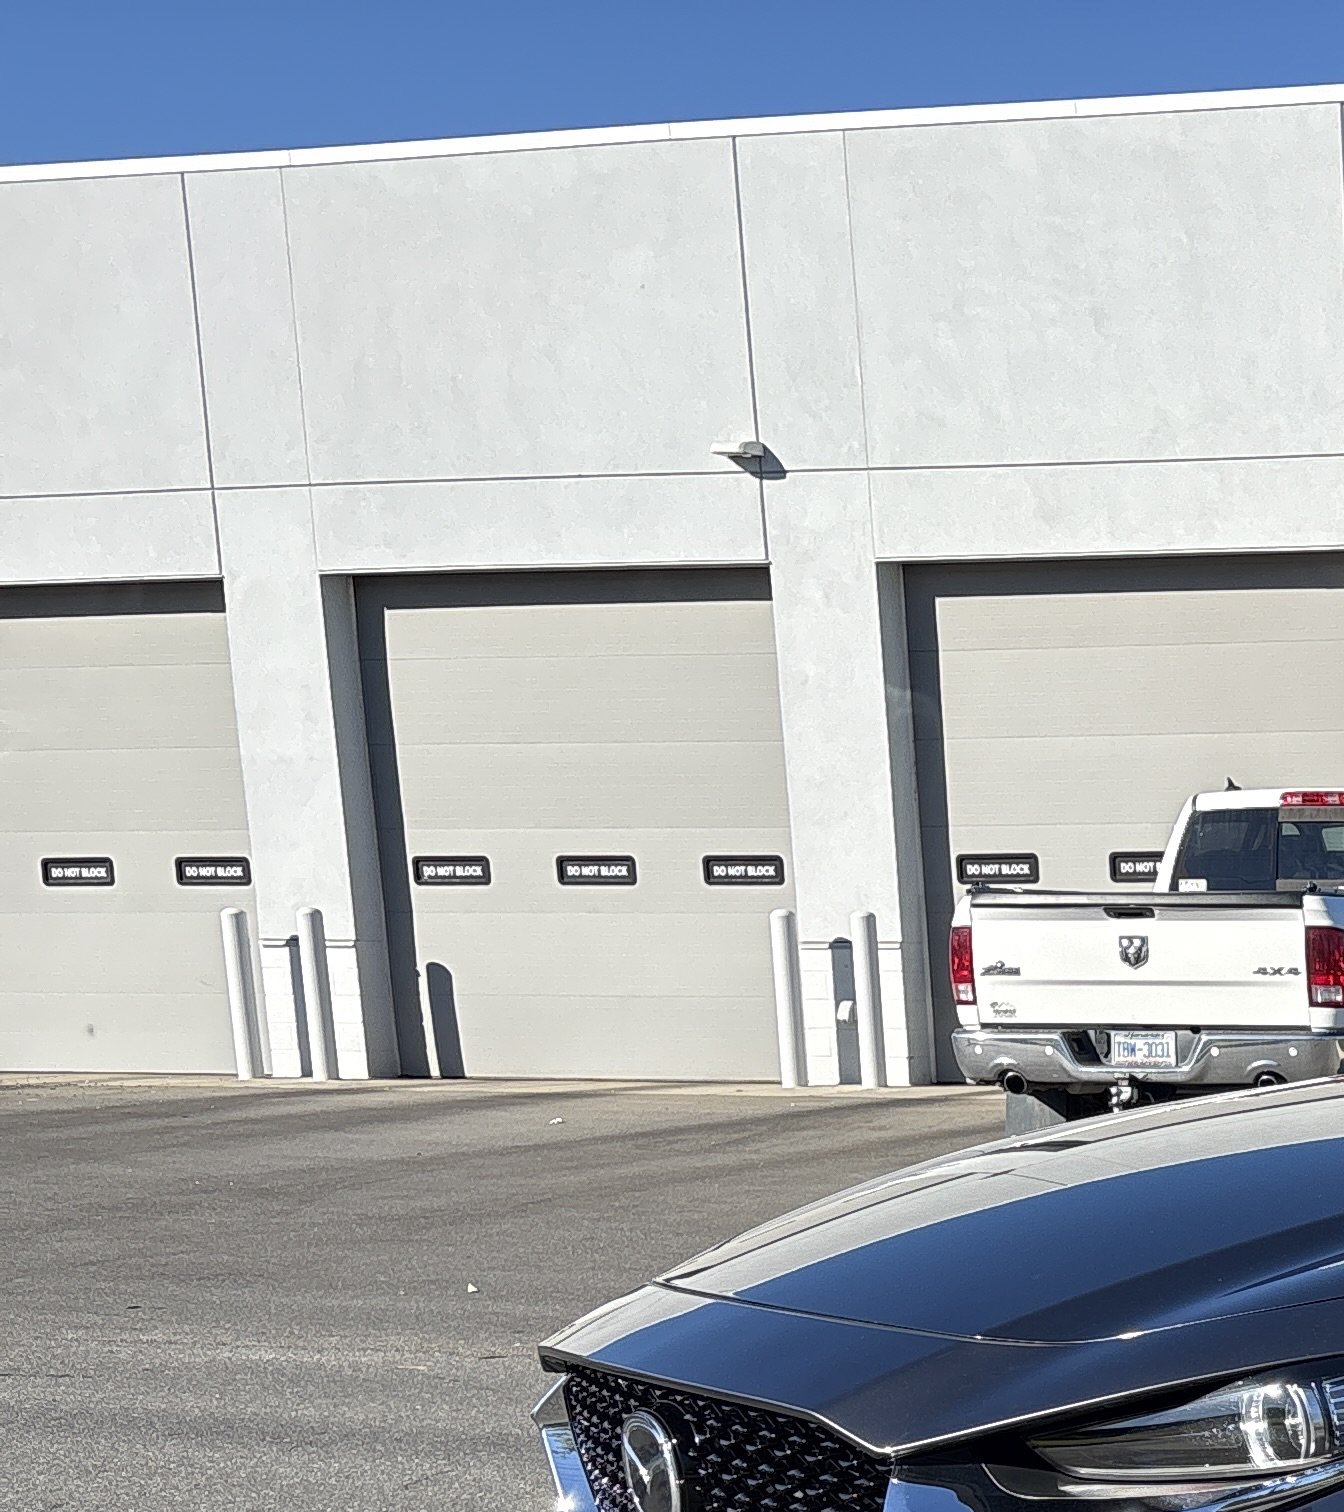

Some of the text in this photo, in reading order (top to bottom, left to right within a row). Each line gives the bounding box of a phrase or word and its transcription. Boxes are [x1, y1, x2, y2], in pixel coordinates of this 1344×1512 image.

[51, 867, 107, 878] DO NOT BLOCK
[185, 866, 243, 877] DO NOT BLOCK
[423, 865, 483, 876] DO NOT BLOCK
[567, 865, 628, 876] DO NOT BLOCK
[713, 865, 776, 876] DO NOT BLOCK
[966, 863, 1030, 875] DO NOT BLOCK
[1120, 861, 1134, 873] DO
[1135, 861, 1155, 873] NOT
